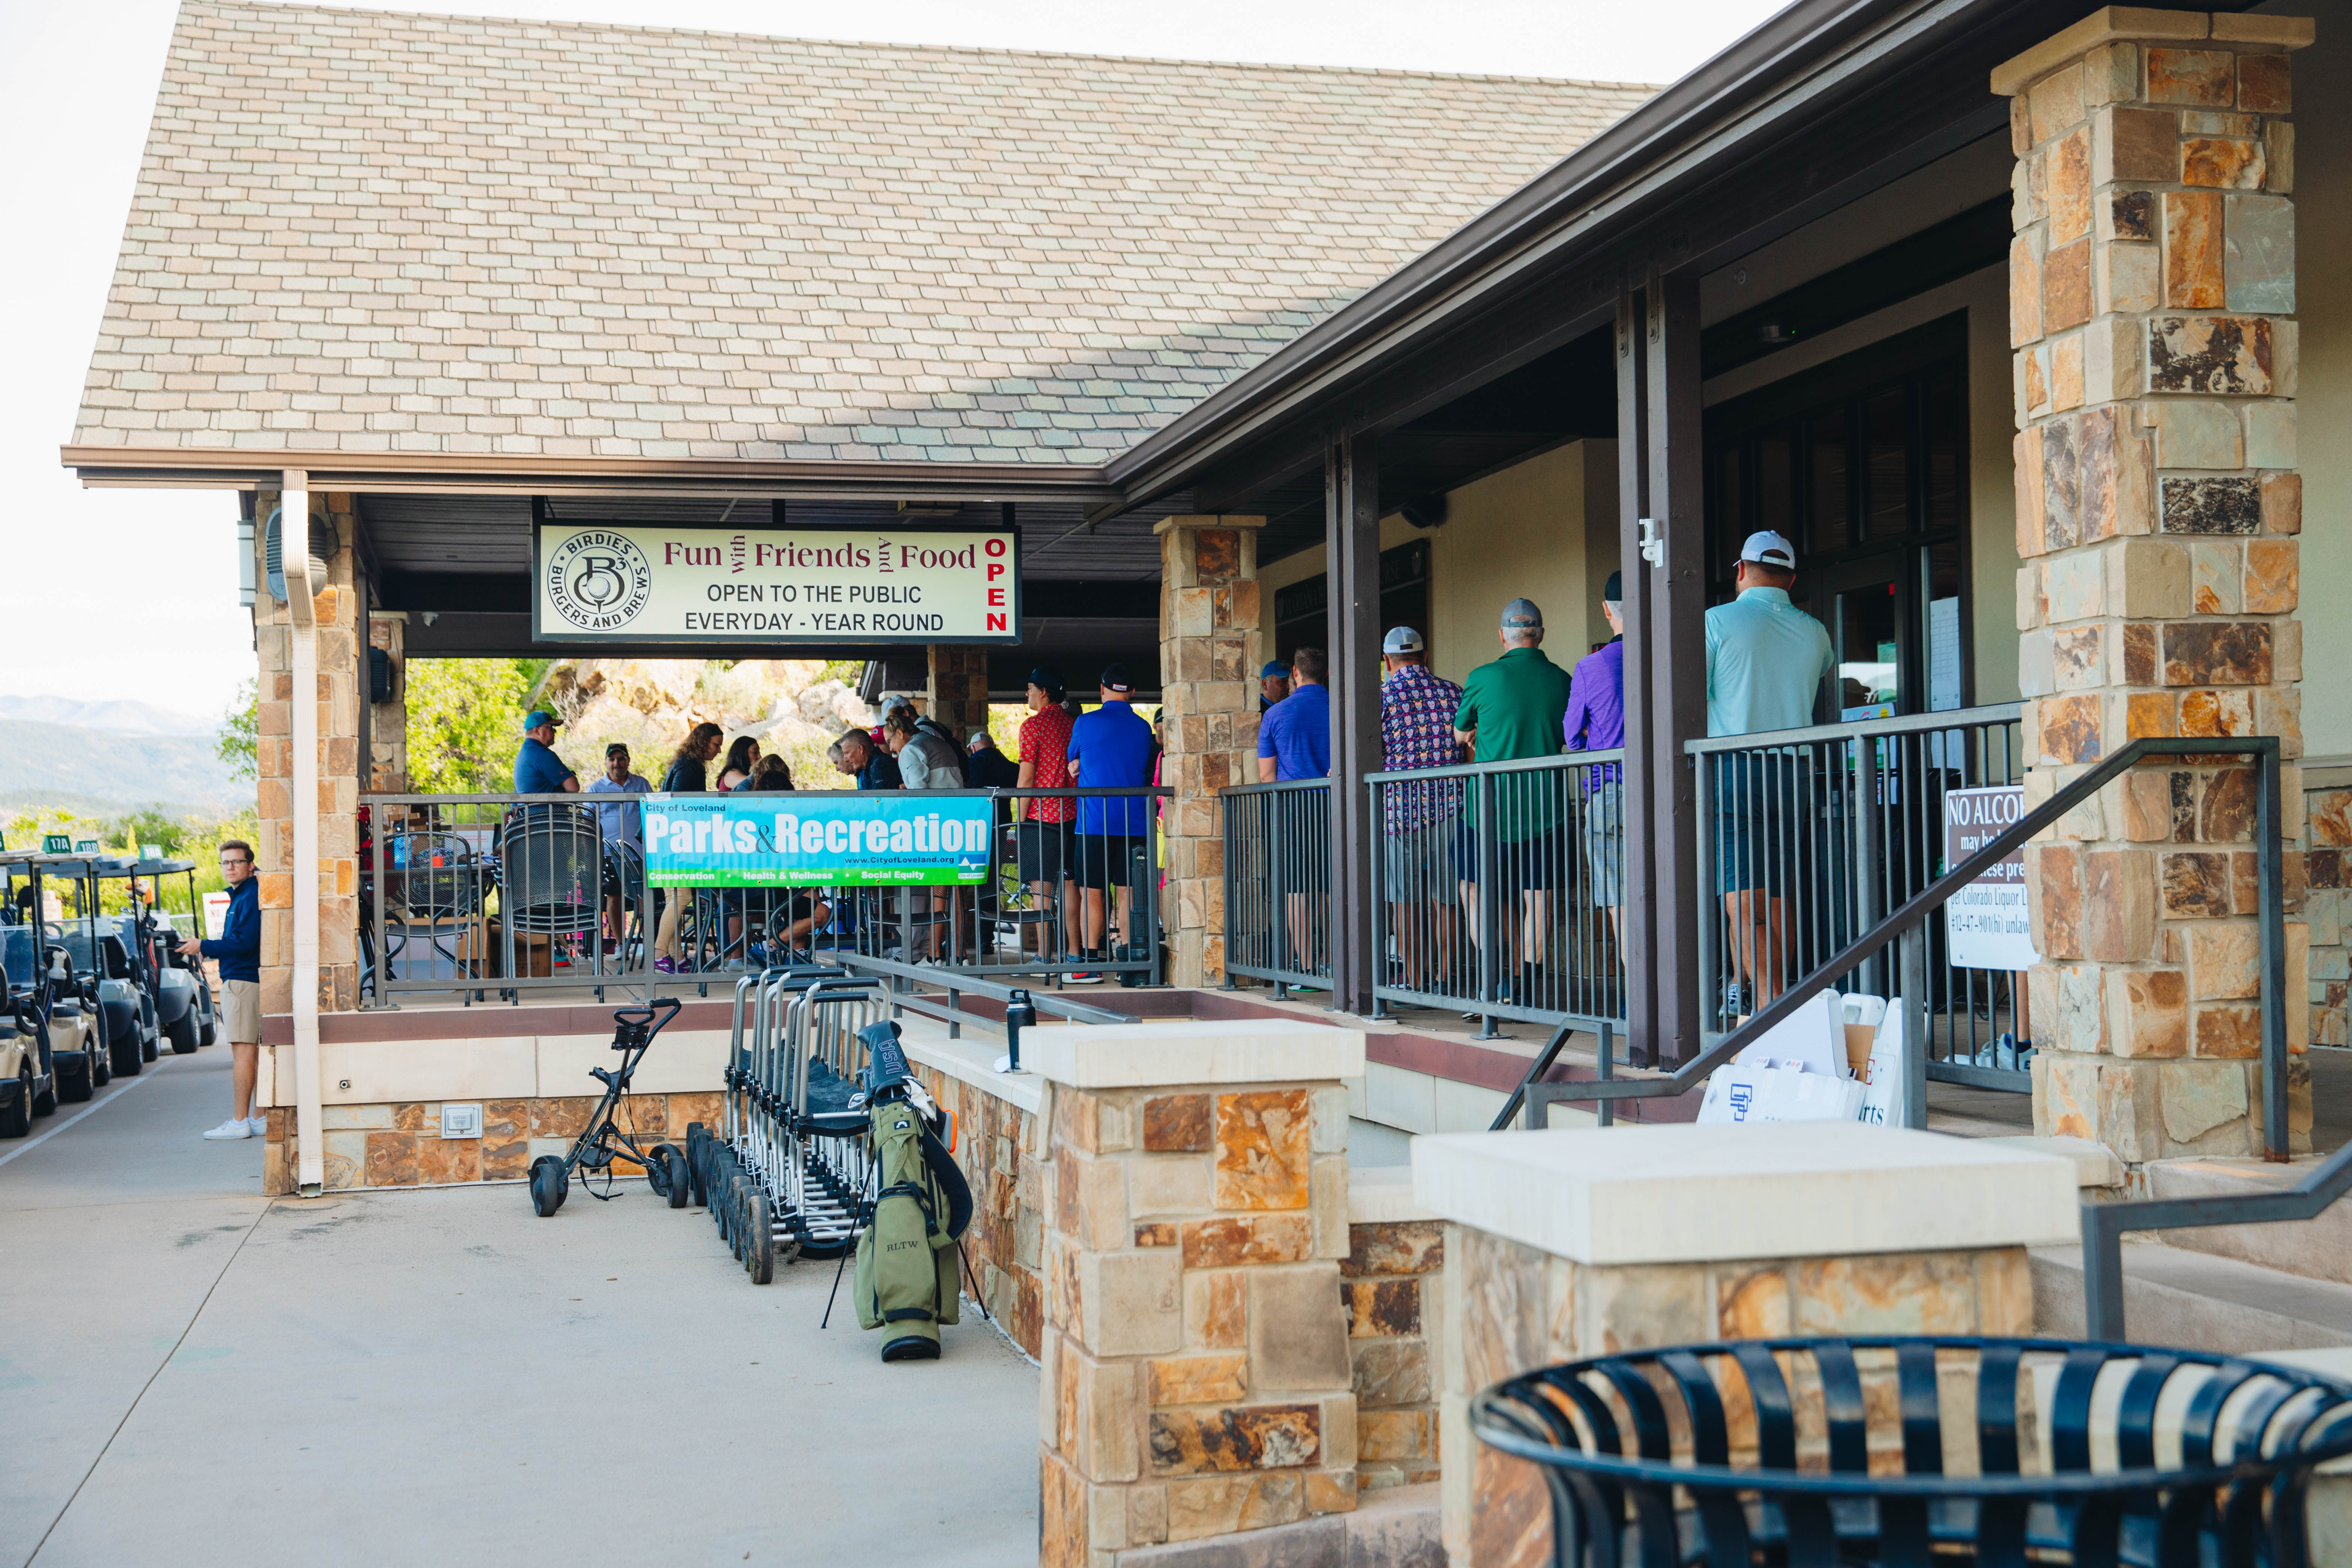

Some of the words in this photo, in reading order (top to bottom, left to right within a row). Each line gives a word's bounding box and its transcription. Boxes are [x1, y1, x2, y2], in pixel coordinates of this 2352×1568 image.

[566, 533, 632, 554] BIRDIES
[664, 542, 723, 565] Fun
[755, 541, 871, 567] Friends
[878, 536, 894, 573] And
[900, 544, 976, 569] Food
[708, 584, 763, 602] OPEN
[770, 585, 797, 602] TO
[803, 585, 842, 603] THE
[850, 586, 921, 603] PUBLIC
[984, 538, 1007, 631] OPEN
[551, 566, 589, 625] BURGERS
[593, 614, 621, 627] AND
[623, 567, 647, 617] BREWS
[686, 612, 793, 630] EVERYDAY
[811, 614, 866, 631] YEAR
[873, 614, 944, 631] ROUND
[646, 805, 665, 813] City
[1949, 797, 1971, 826] NO
[645, 814, 757, 853] Parks
[775, 813, 987, 853] Recreation
[50, 838, 69, 850] 17A
[80, 842, 99, 853] 18B
[145, 847, 161, 858] 18A
[1961, 836, 1980, 853] may
[845, 856, 954, 865] www.CityofLoveland.org
[649, 872, 715, 880] Conservation
[743, 872, 776, 880] Health
[789, 871, 833, 880] Wellness
[861, 871, 891, 879] Social
[894, 871, 924, 880] Equity
[1950, 891, 1960, 909] per
[1962, 886, 1992, 905] Colorado
[1995, 886, 2019, 910] Liquor
[878, 1038, 903, 1075] USA
[887, 1241, 918, 1251] RLTW
